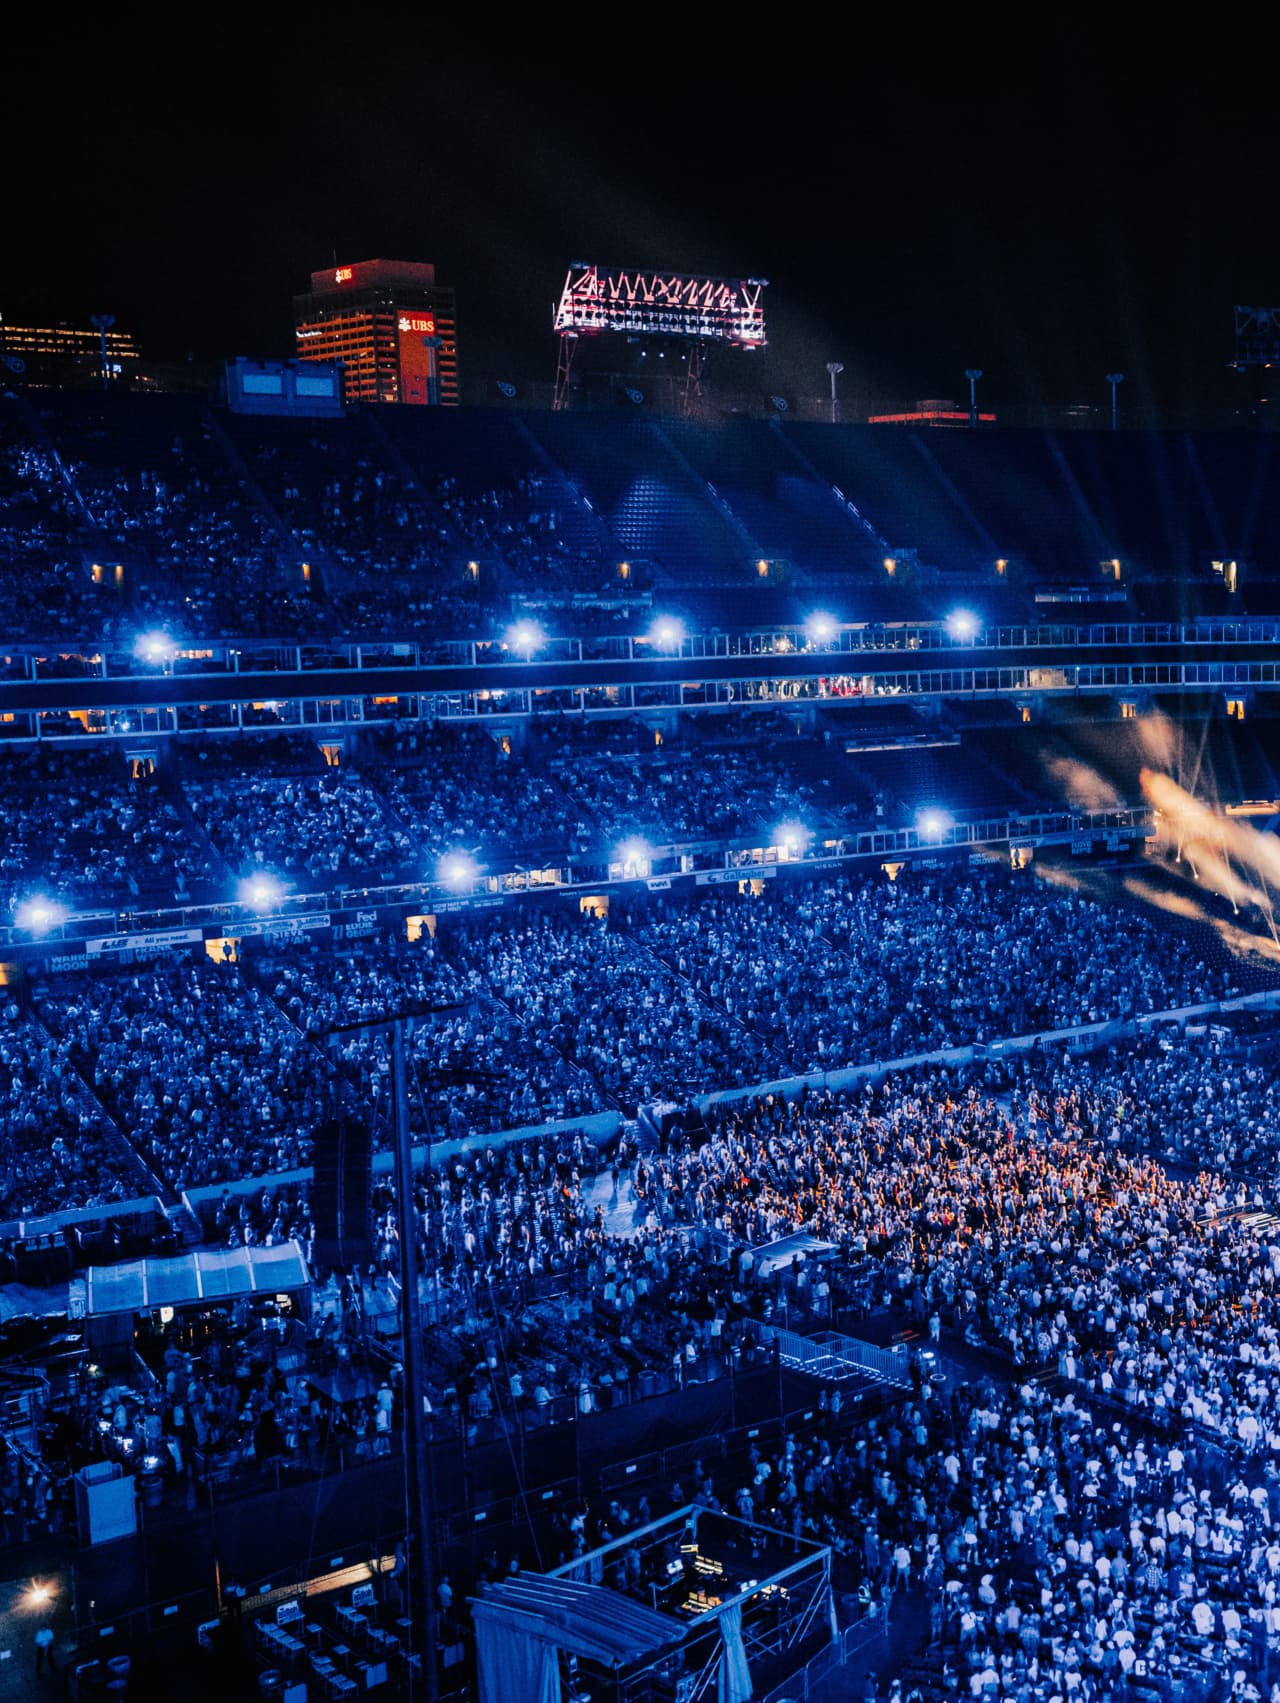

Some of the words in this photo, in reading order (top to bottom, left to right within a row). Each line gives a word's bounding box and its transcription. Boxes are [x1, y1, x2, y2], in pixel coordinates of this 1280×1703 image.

[340, 268, 352, 280] UBS
[411, 320, 435, 332] UBS
[723, 870, 765, 881] Gallagher
[357, 910, 377, 922] Fed
[51, 960, 89, 973] MOON
